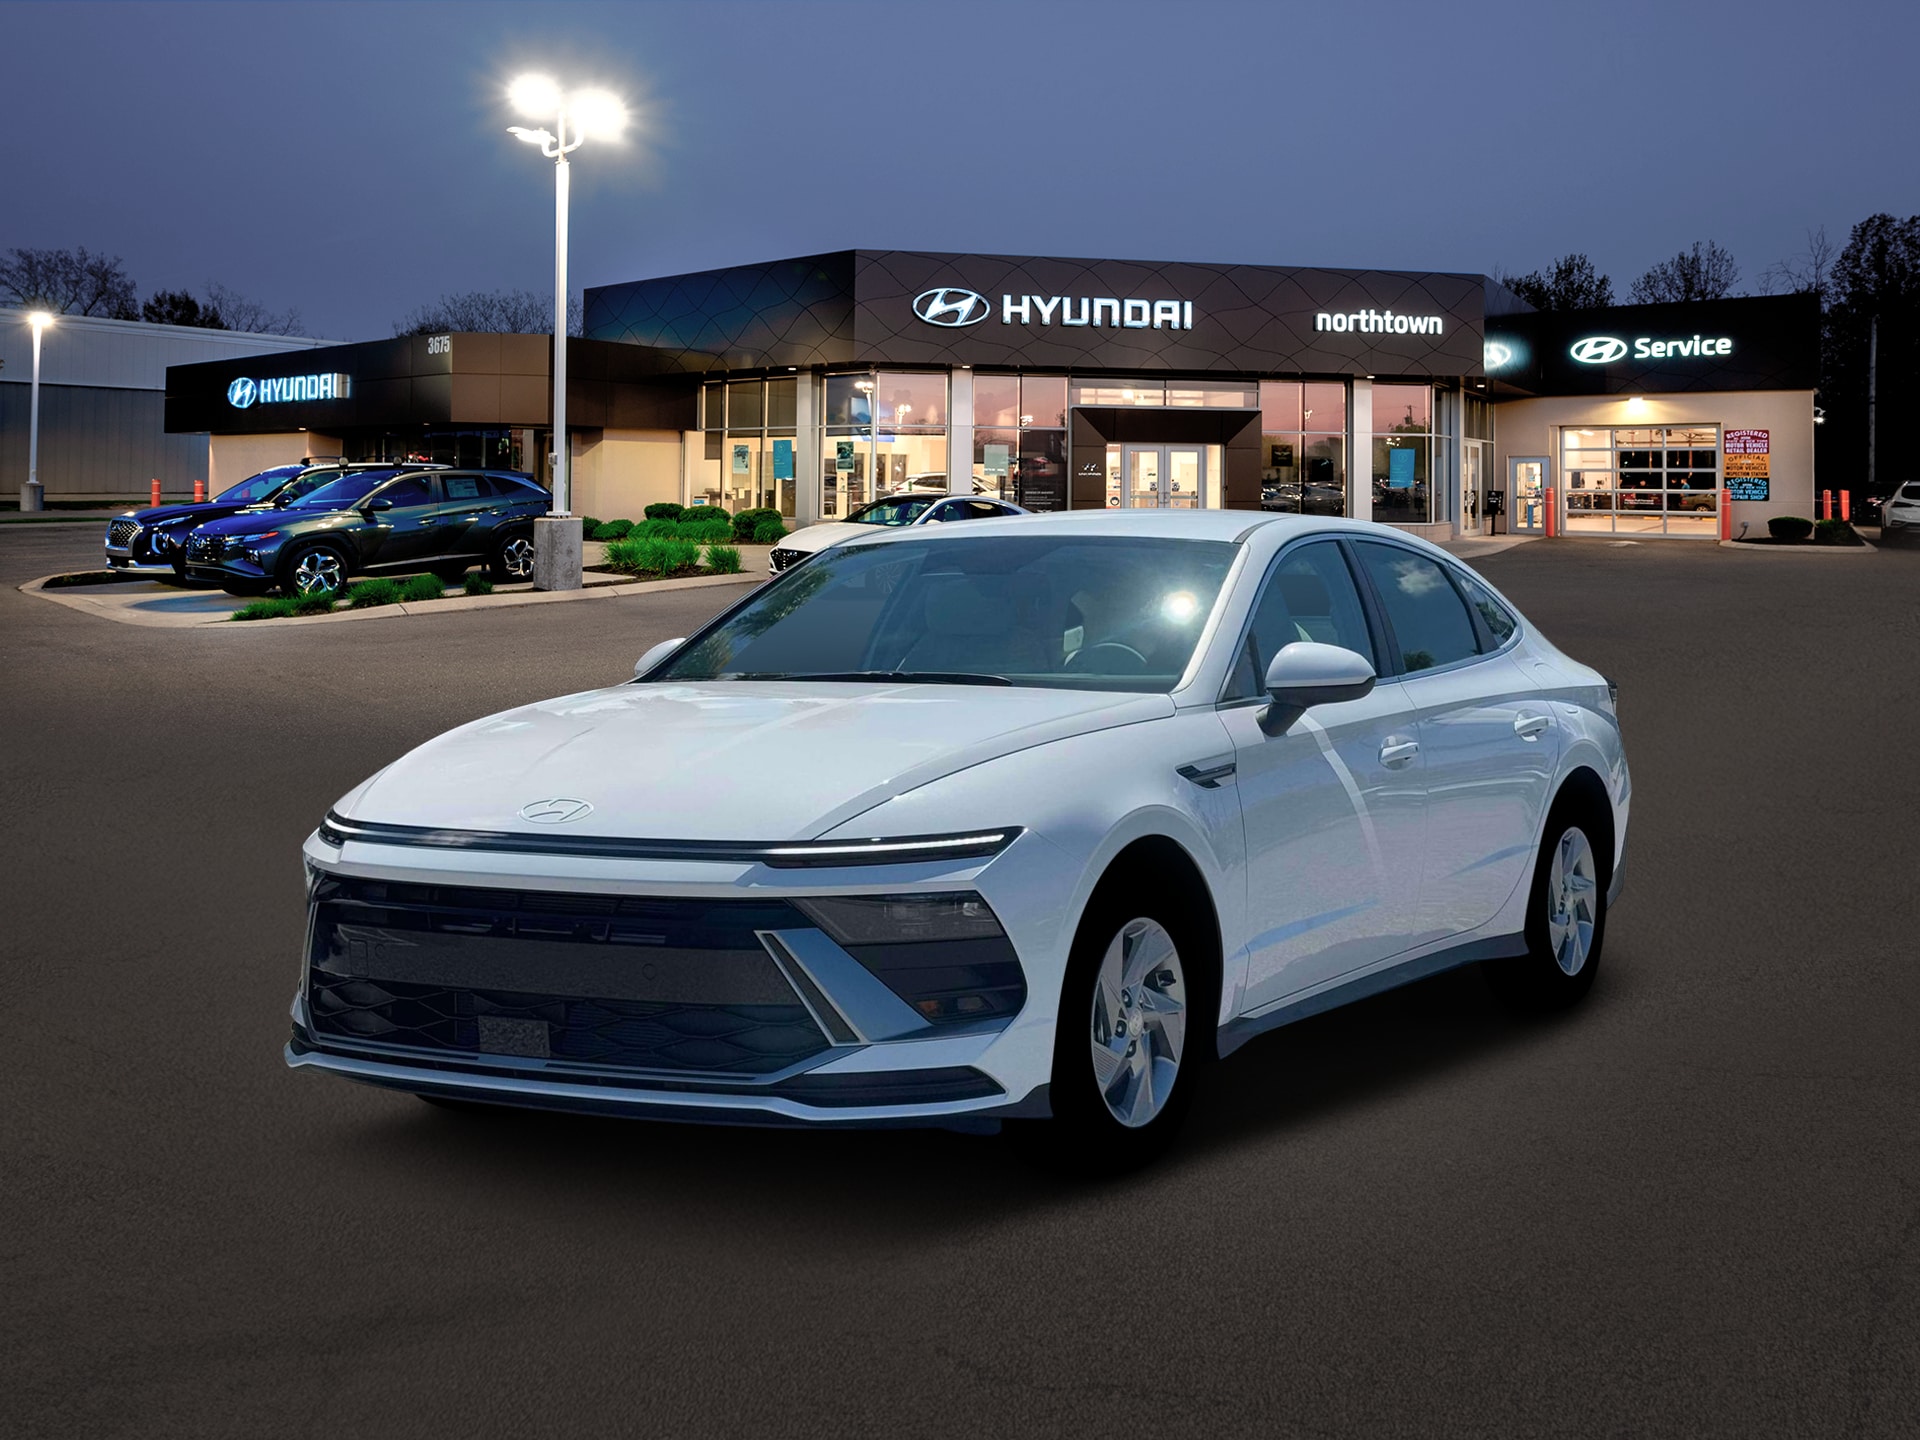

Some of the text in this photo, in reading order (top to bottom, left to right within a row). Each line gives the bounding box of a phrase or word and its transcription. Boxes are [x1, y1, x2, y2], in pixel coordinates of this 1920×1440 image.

[1002, 294, 1193, 330] HYUNDAI
[1316, 309, 1443, 334] northtown
[428, 335, 450, 355] 3675
[1634, 335, 1733, 358] Service
[260, 373, 341, 403] HYUNDAI
[1726, 430, 1768, 438] REGISTERED
[1726, 477, 1767, 486] REGISTERED
